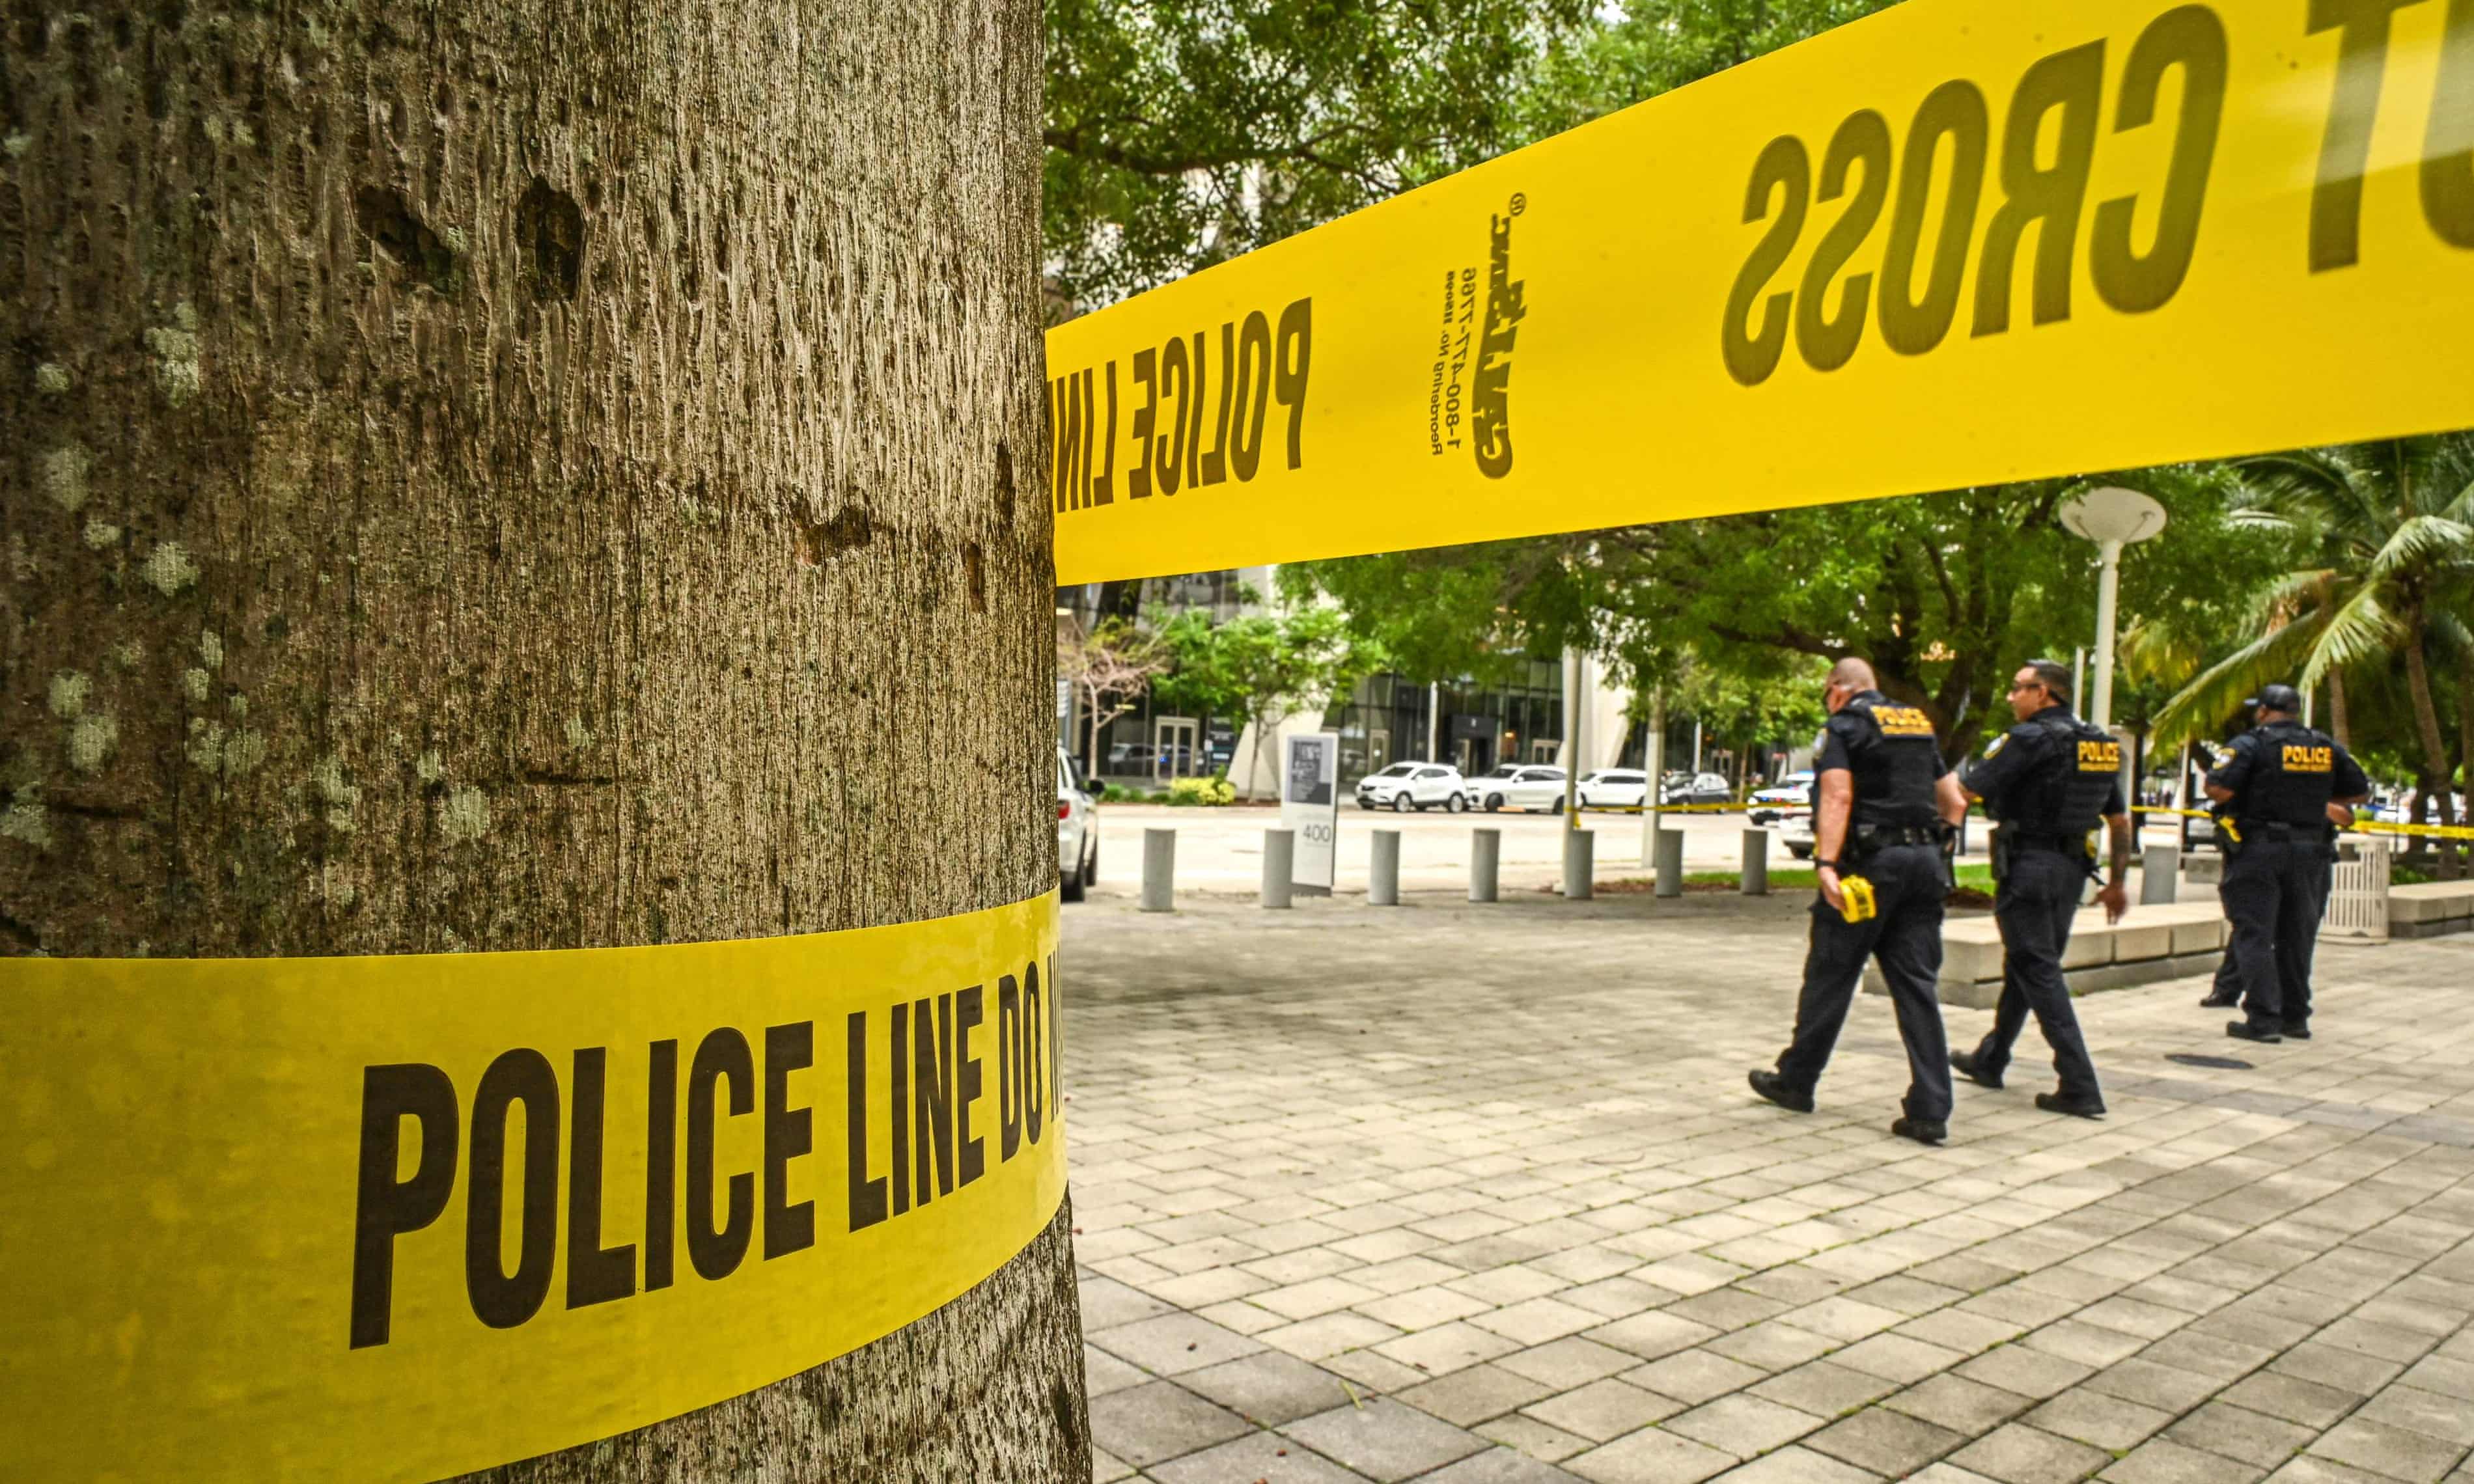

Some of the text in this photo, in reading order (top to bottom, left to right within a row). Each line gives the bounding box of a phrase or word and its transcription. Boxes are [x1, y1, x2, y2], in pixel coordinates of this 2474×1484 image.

[1869, 706, 1932, 727] POLICE
[2078, 740, 2120, 762] POLICE
[2281, 745, 2333, 764] POLICE
[1303, 824, 1331, 843] 400
[350, 1020, 816, 1350] POLICE
[846, 983, 985, 1233] LINE
[999, 959, 1042, 1163] DO
